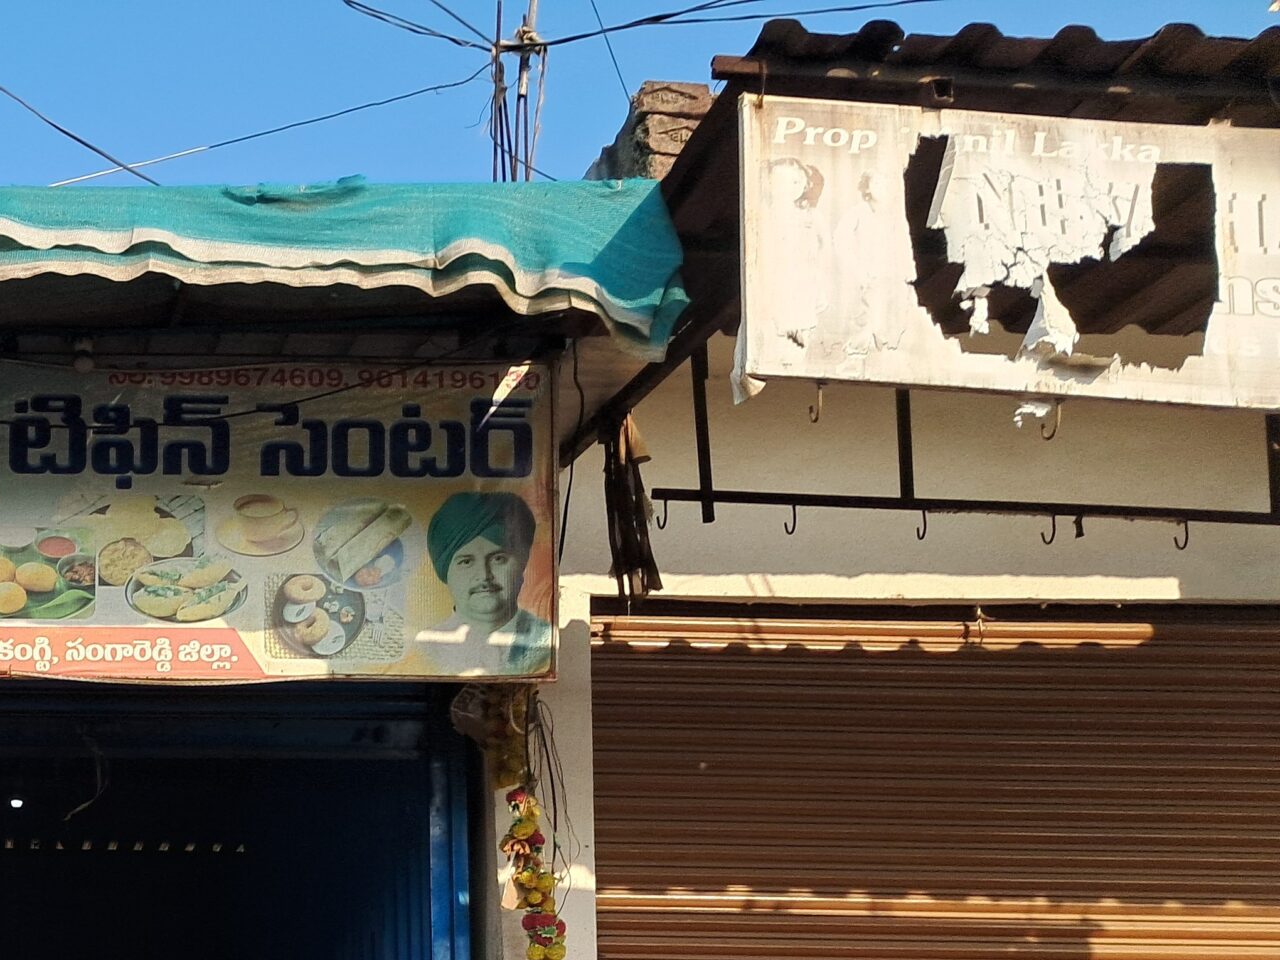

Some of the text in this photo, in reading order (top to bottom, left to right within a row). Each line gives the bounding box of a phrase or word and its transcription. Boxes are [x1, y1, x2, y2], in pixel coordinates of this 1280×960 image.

[773, 117, 877, 154] Prop
[9, 392, 231, 490] టిఫిన్
[260, 397, 535, 479] సెంటర్
